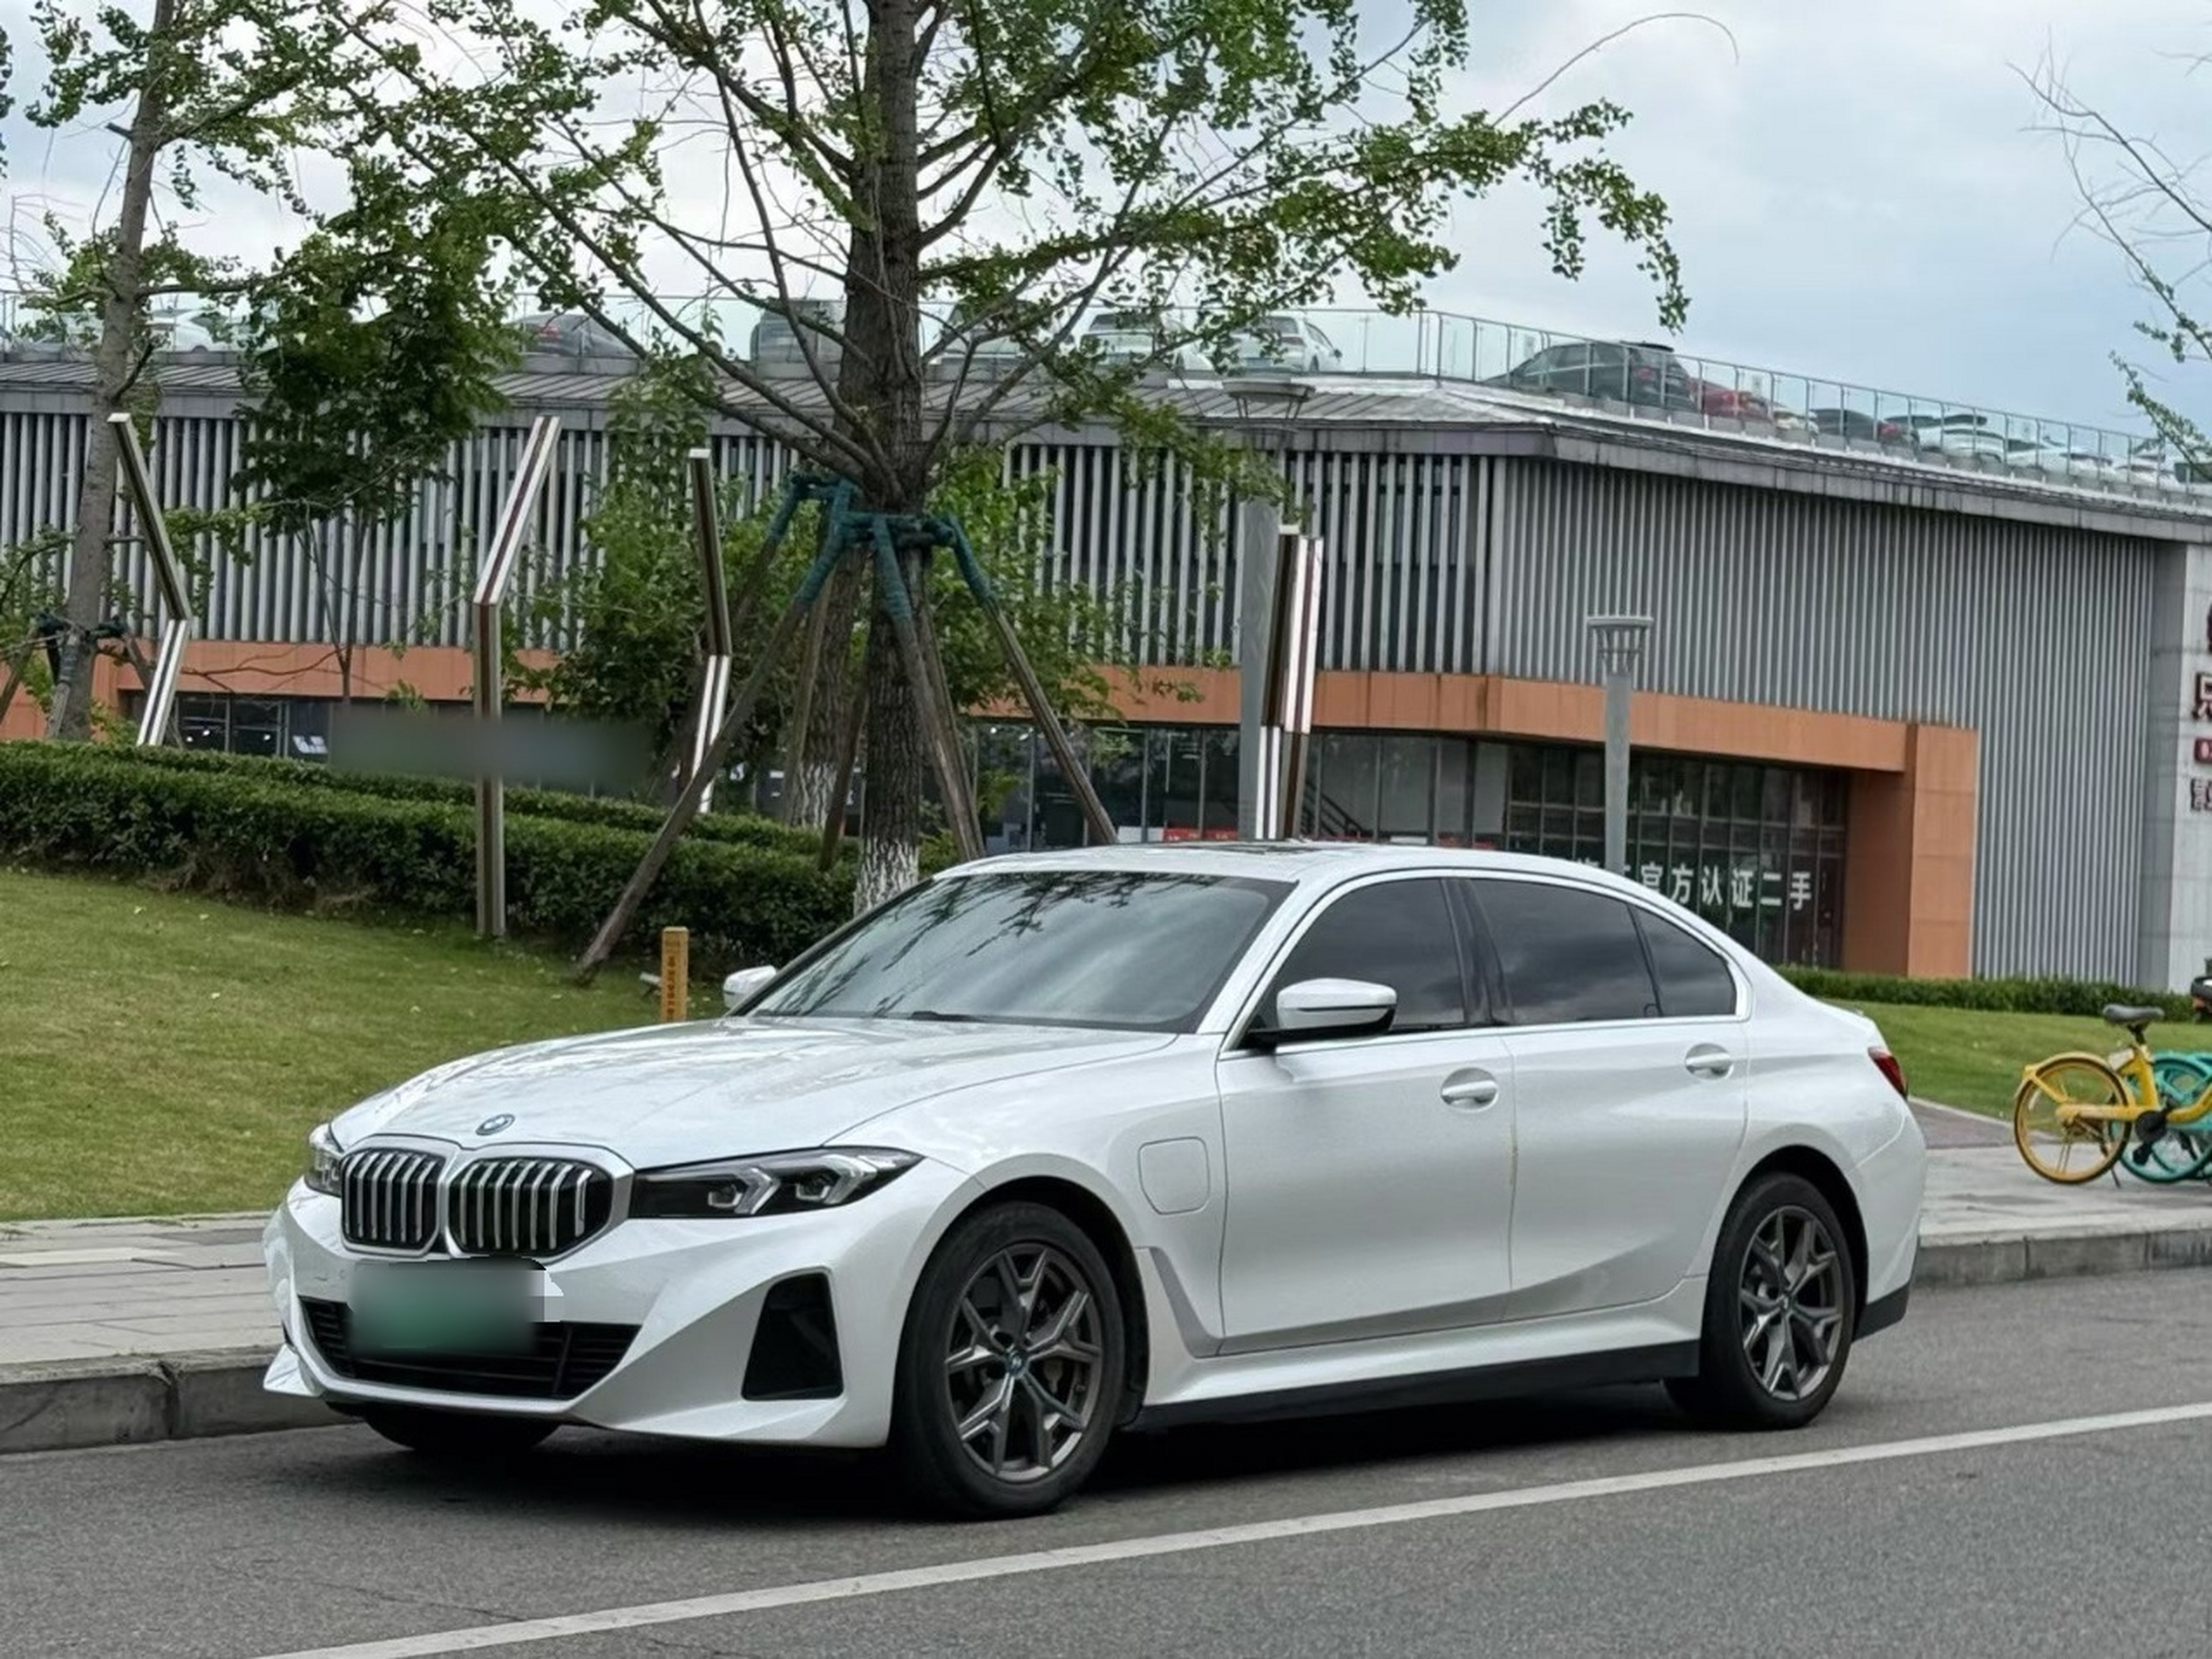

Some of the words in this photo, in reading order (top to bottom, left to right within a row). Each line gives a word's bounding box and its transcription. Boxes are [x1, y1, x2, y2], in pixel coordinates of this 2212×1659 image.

[1577, 857, 1812, 910] 官方认证二手
